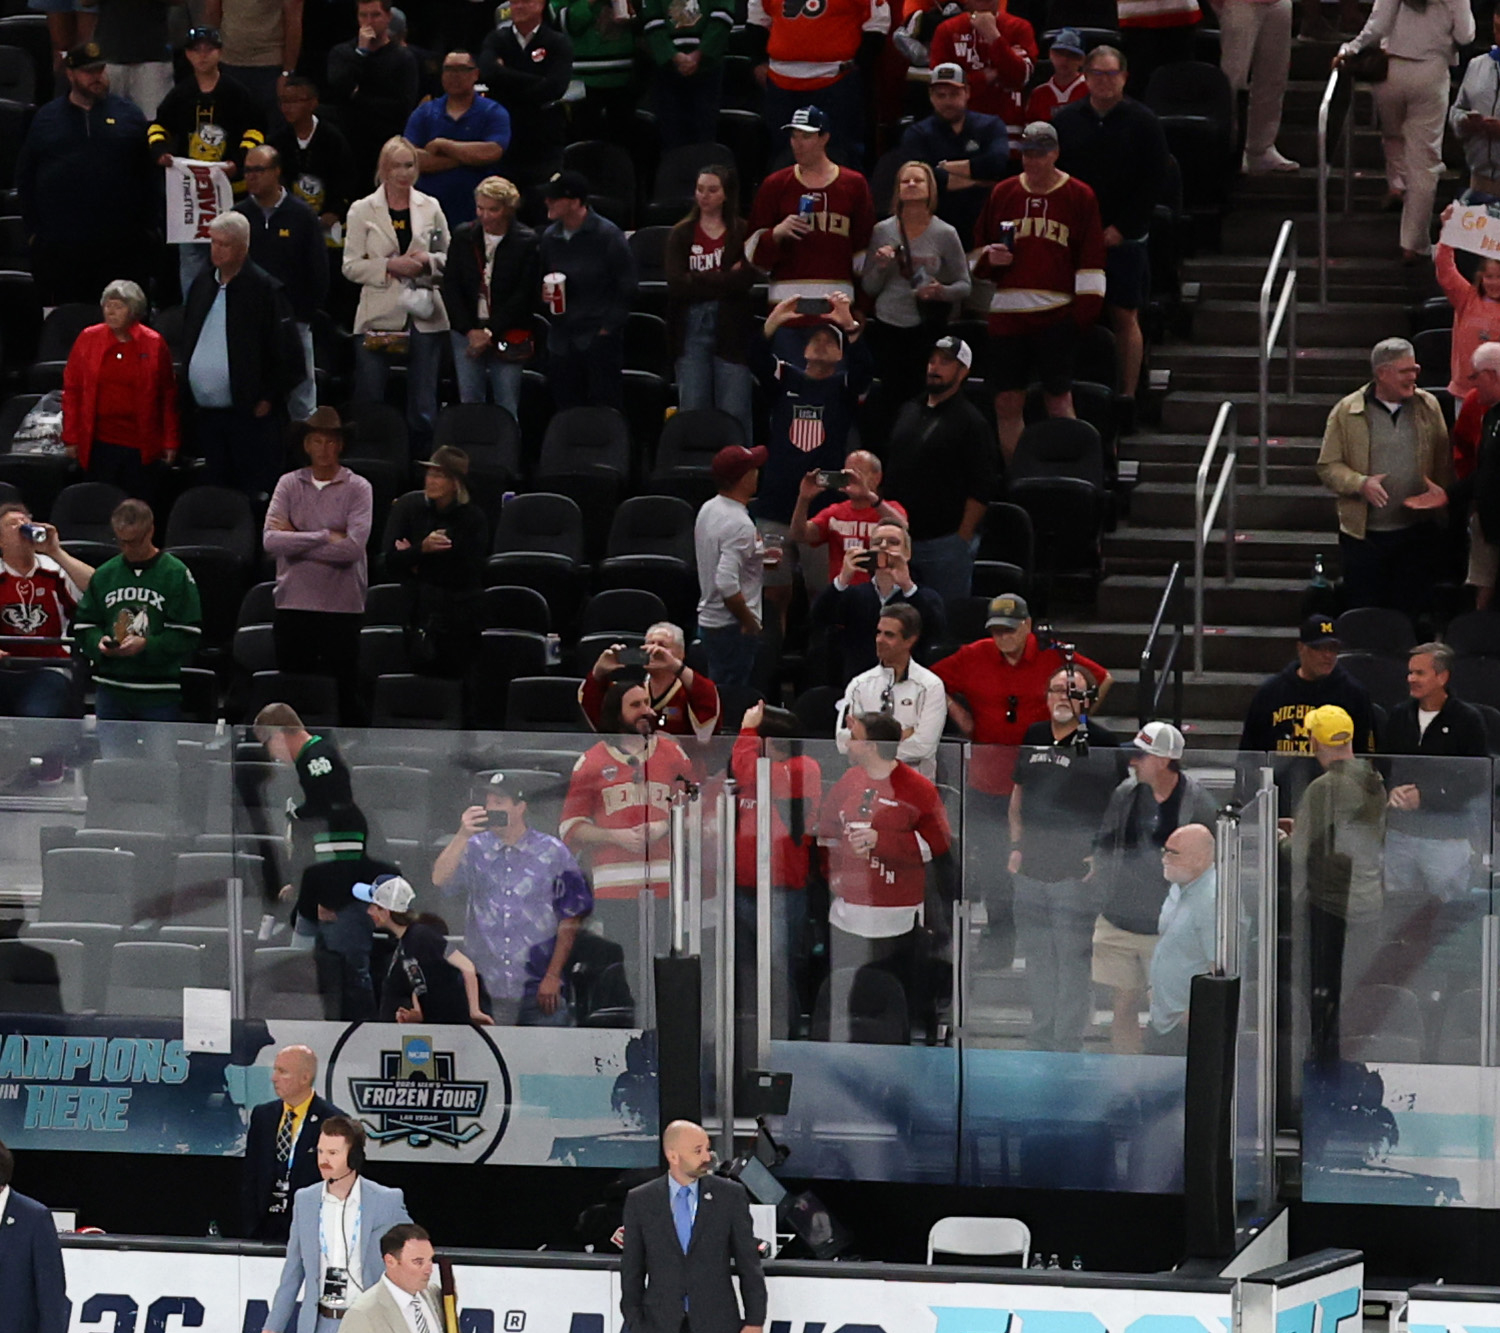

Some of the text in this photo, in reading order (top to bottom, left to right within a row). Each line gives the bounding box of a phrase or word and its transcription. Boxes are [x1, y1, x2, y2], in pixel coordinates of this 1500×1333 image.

[182, 173, 193, 226] ATHLETICS
[189, 167, 213, 241] DENVER
[1460, 209, 1487, 229] GO
[103, 586, 166, 612] SIOUX
[1320, 622, 1333, 633] M
[23, 1085, 134, 1132] HERE
[363, 1087, 477, 1109] FROZEN FOUR
